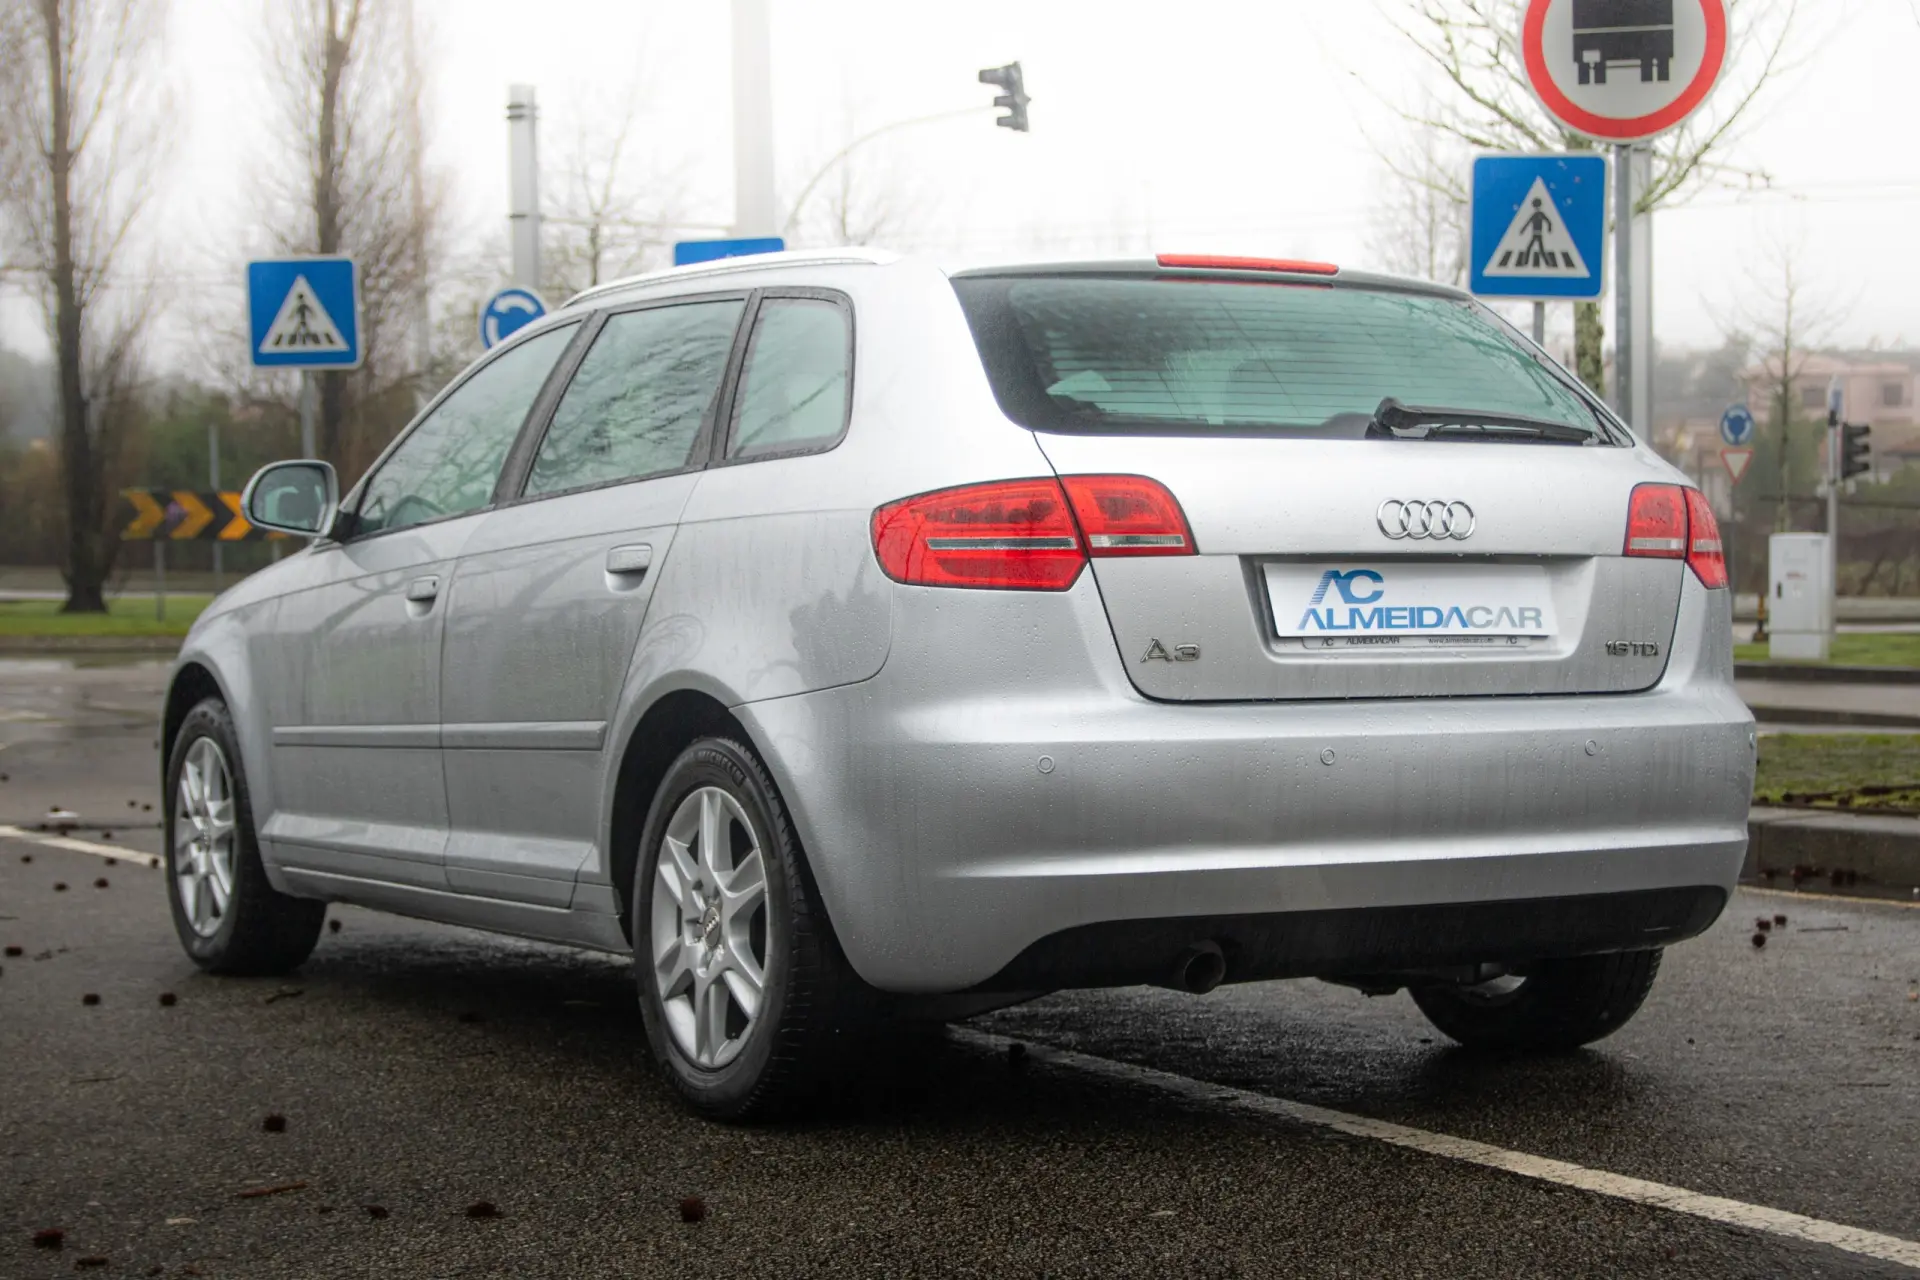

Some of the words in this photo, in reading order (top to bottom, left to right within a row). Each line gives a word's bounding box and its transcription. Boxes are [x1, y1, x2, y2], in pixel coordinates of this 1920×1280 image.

[1309, 569, 1384, 605] AC
[1297, 606, 1543, 630] ALMEIDACAR
[1140, 637, 1201, 663] A3
